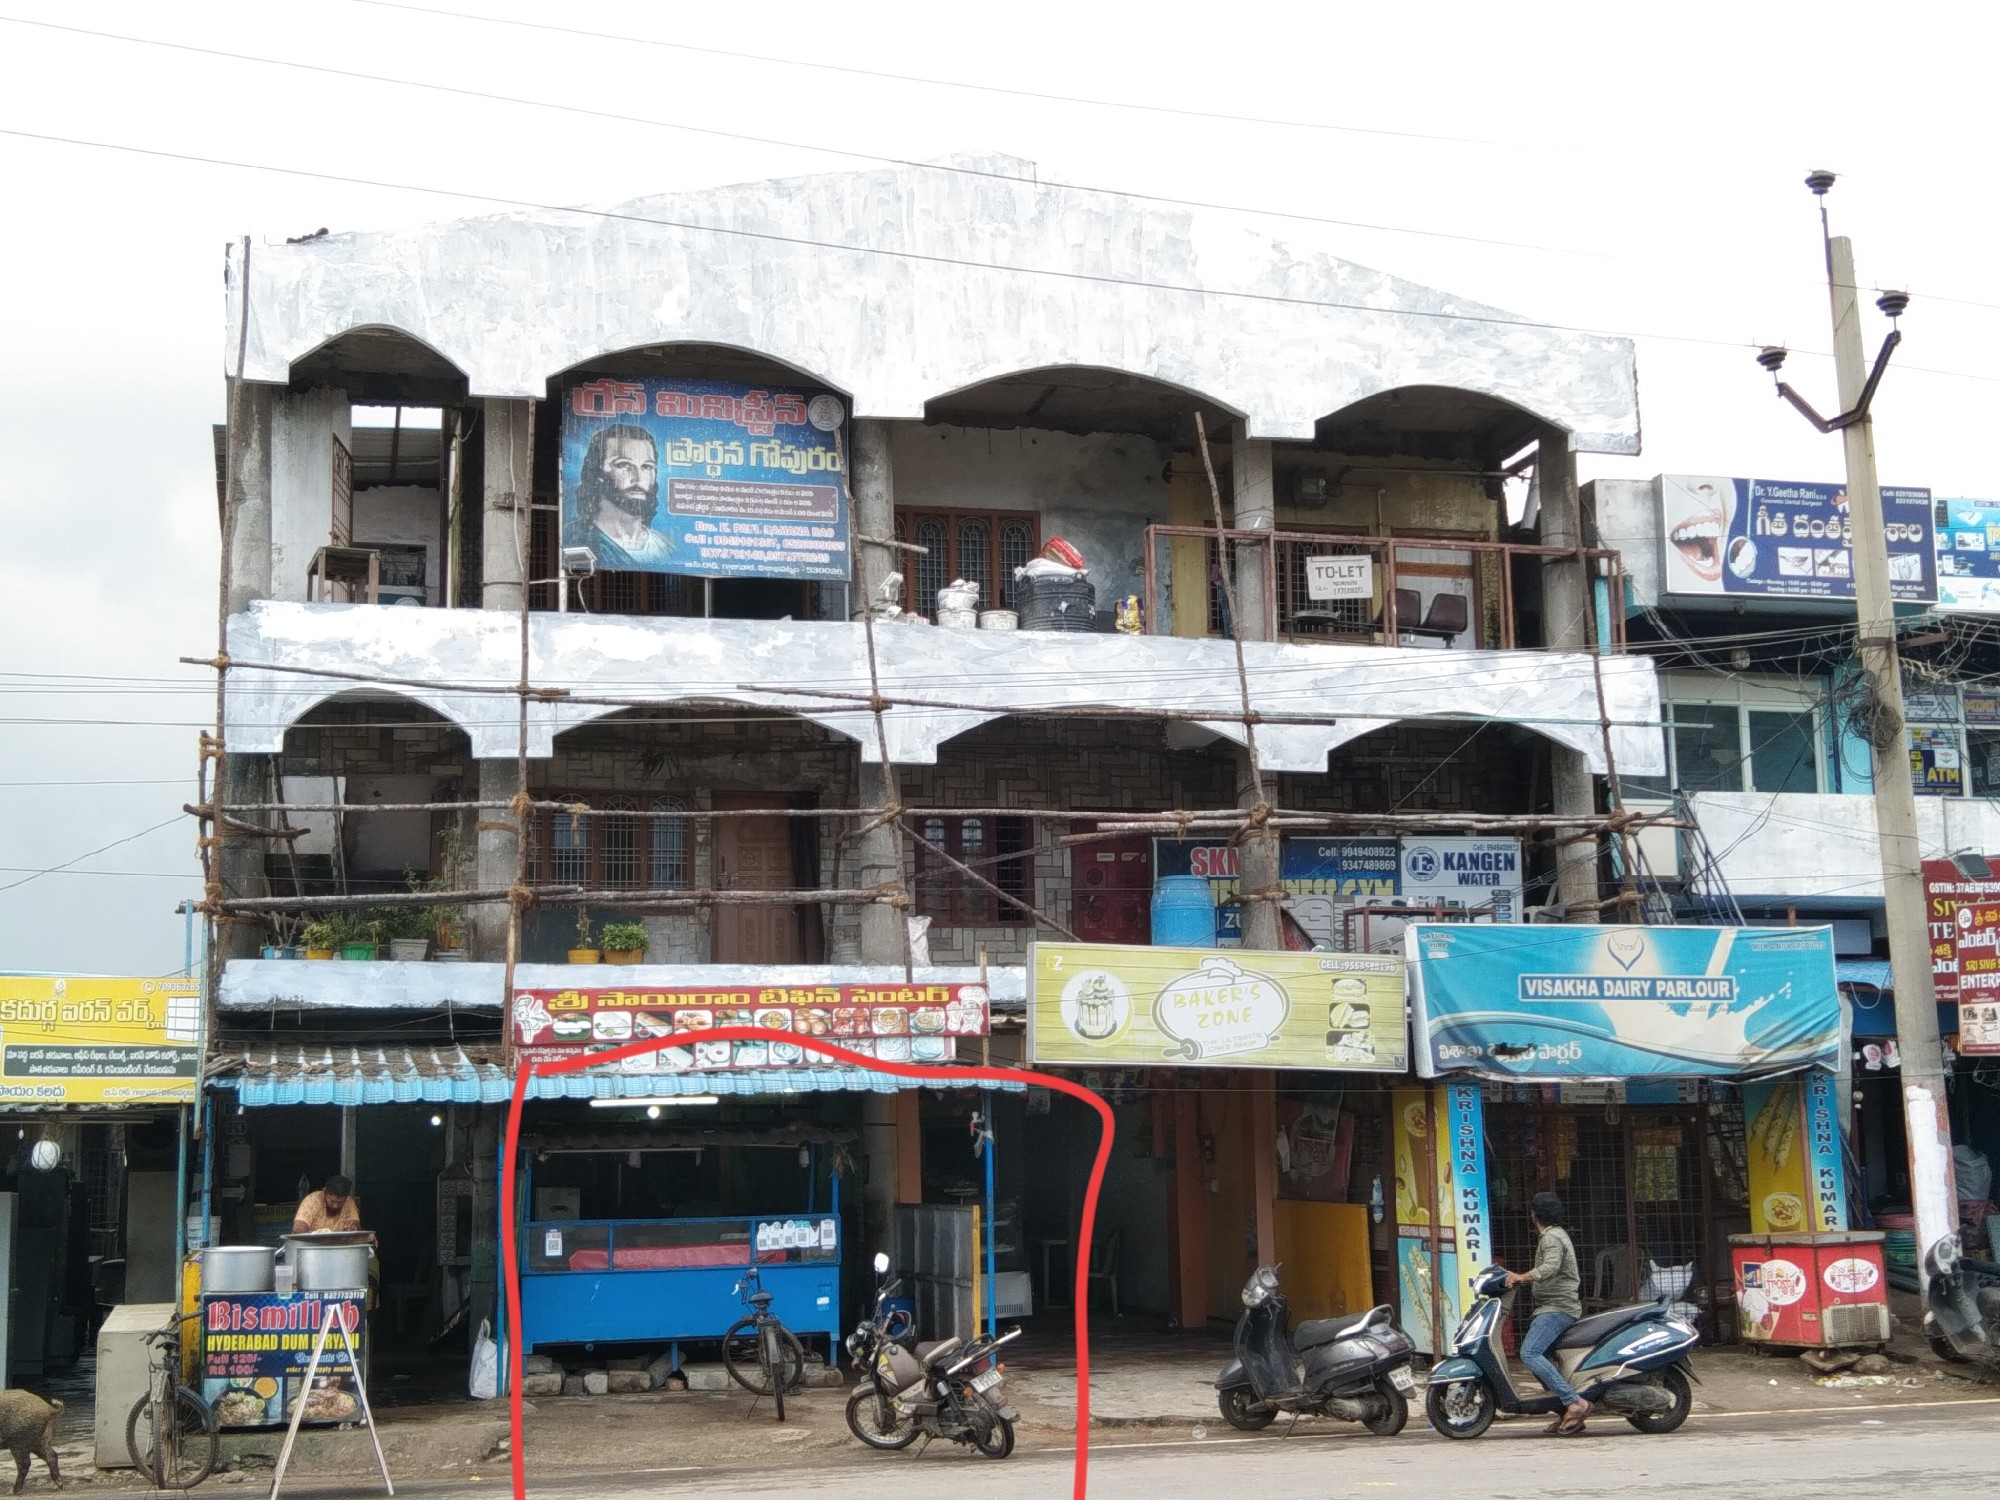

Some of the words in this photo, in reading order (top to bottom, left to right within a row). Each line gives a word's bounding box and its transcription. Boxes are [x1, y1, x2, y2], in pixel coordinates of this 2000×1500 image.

[573, 379, 646, 417] గ్రేస్
[750, 440, 842, 474] గోపురం
[1755, 486, 1765, 496] Dr.
[1767, 487, 1798, 498] Y.Geetha
[1315, 566, 1365, 579] TO-LET
[1927, 767, 1959, 783] ATM
[1319, 848, 1338, 857] Cell:
[1444, 852, 1515, 871] KANGEN
[1458, 873, 1500, 886] WATER
[1929, 883, 1954, 893] GSTIN:
[1420, 933, 1456, 941] NATURAL
[1321, 960, 1340, 969] CELL
[157, 983, 200, 992] 709363285
[1173, 983, 1260, 1008] BAKER'S
[1525, 979, 1599, 996] VISAKHA
[1603, 979, 1650, 997] DAIRY
[1656, 981, 1730, 998] PARLOUR
[548, 991, 588, 1010] శ్రీ
[851, 986, 949, 1003] సెంటర్
[62, 998, 112, 1022] ఐరన్
[1197, 1006, 1252, 1028] ZONE
[97, 1065, 103, 1073] &
[1812, 1073, 1834, 1155] KRISHNA
[1456, 1087, 1479, 1174] KRISHNA
[1819, 1168, 1838, 1232] KUMAR
[1462, 1188, 1481, 1262] KUMARI
[207, 1334, 278, 1351] HYDERABAD
[282, 1334, 308, 1349] DUM
[312, 1333, 359, 1349] BRYANI
[207, 1354, 229, 1363] Full
